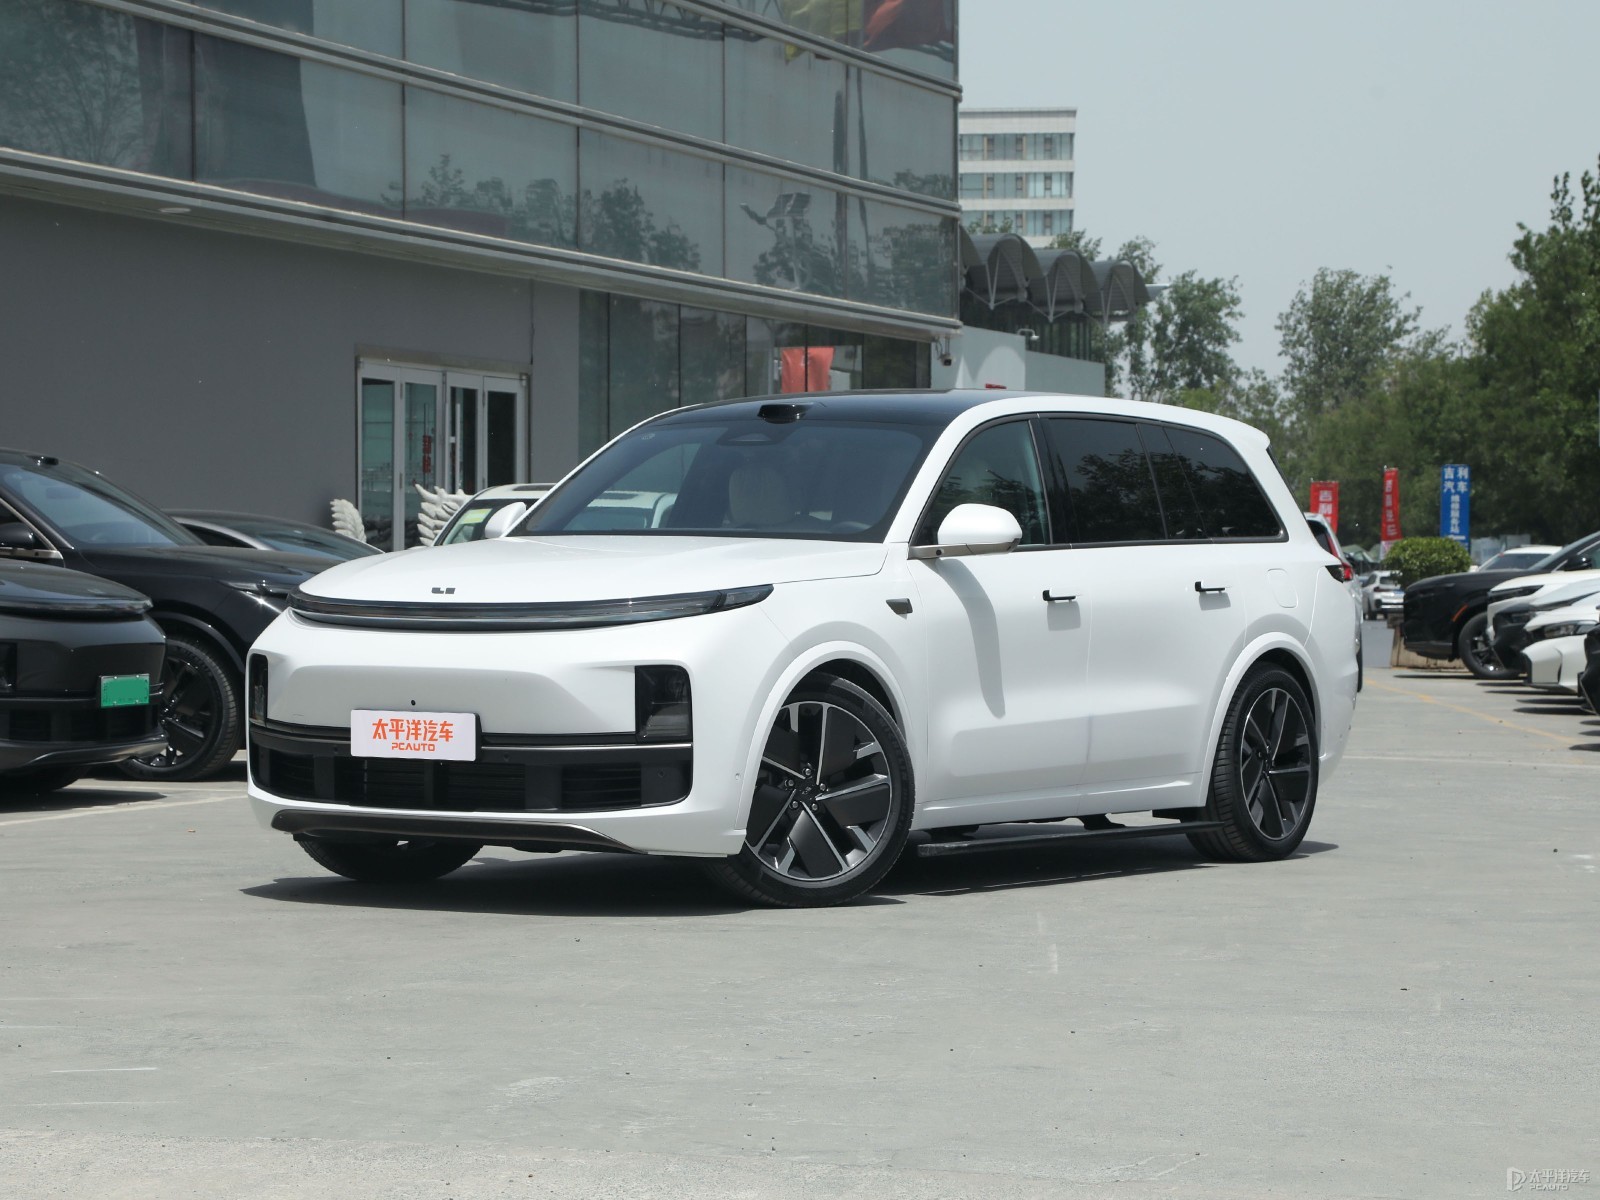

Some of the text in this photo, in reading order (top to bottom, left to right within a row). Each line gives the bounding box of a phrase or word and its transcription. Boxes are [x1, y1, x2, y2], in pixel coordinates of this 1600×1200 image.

[1444, 466, 1469, 480] 吉利
[372, 718, 454, 742] 太平洋汽车
[391, 742, 436, 752] PCAUTO
